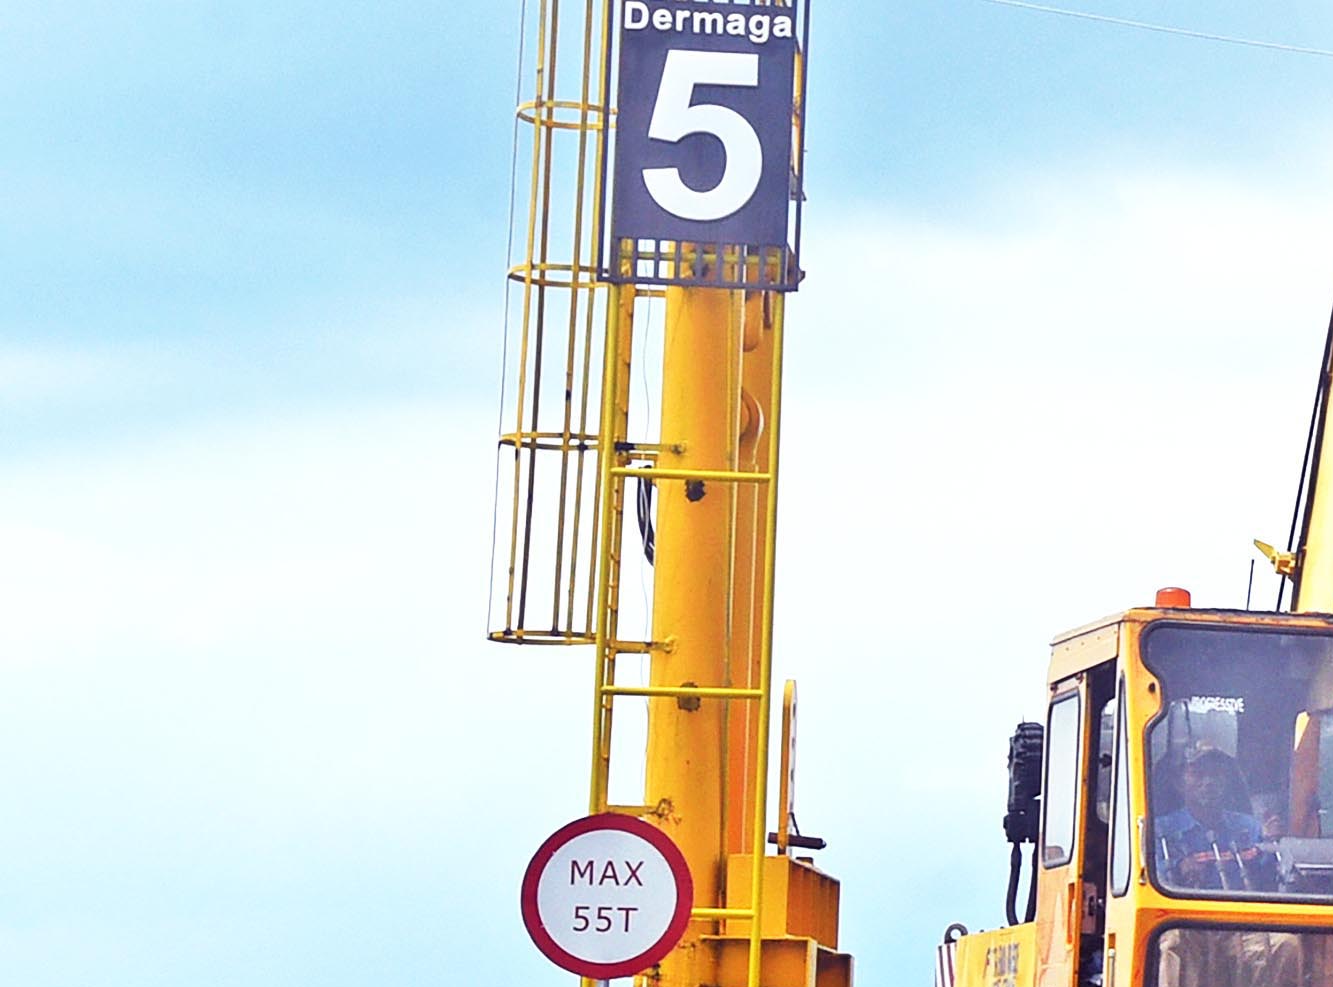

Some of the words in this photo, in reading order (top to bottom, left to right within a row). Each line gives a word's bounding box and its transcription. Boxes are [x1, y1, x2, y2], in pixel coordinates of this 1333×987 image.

[624, 1, 793, 43] Dermaga
[641, 49, 763, 221] 5
[570, 860, 644, 887] MAX
[572, 906, 639, 932] 55T
